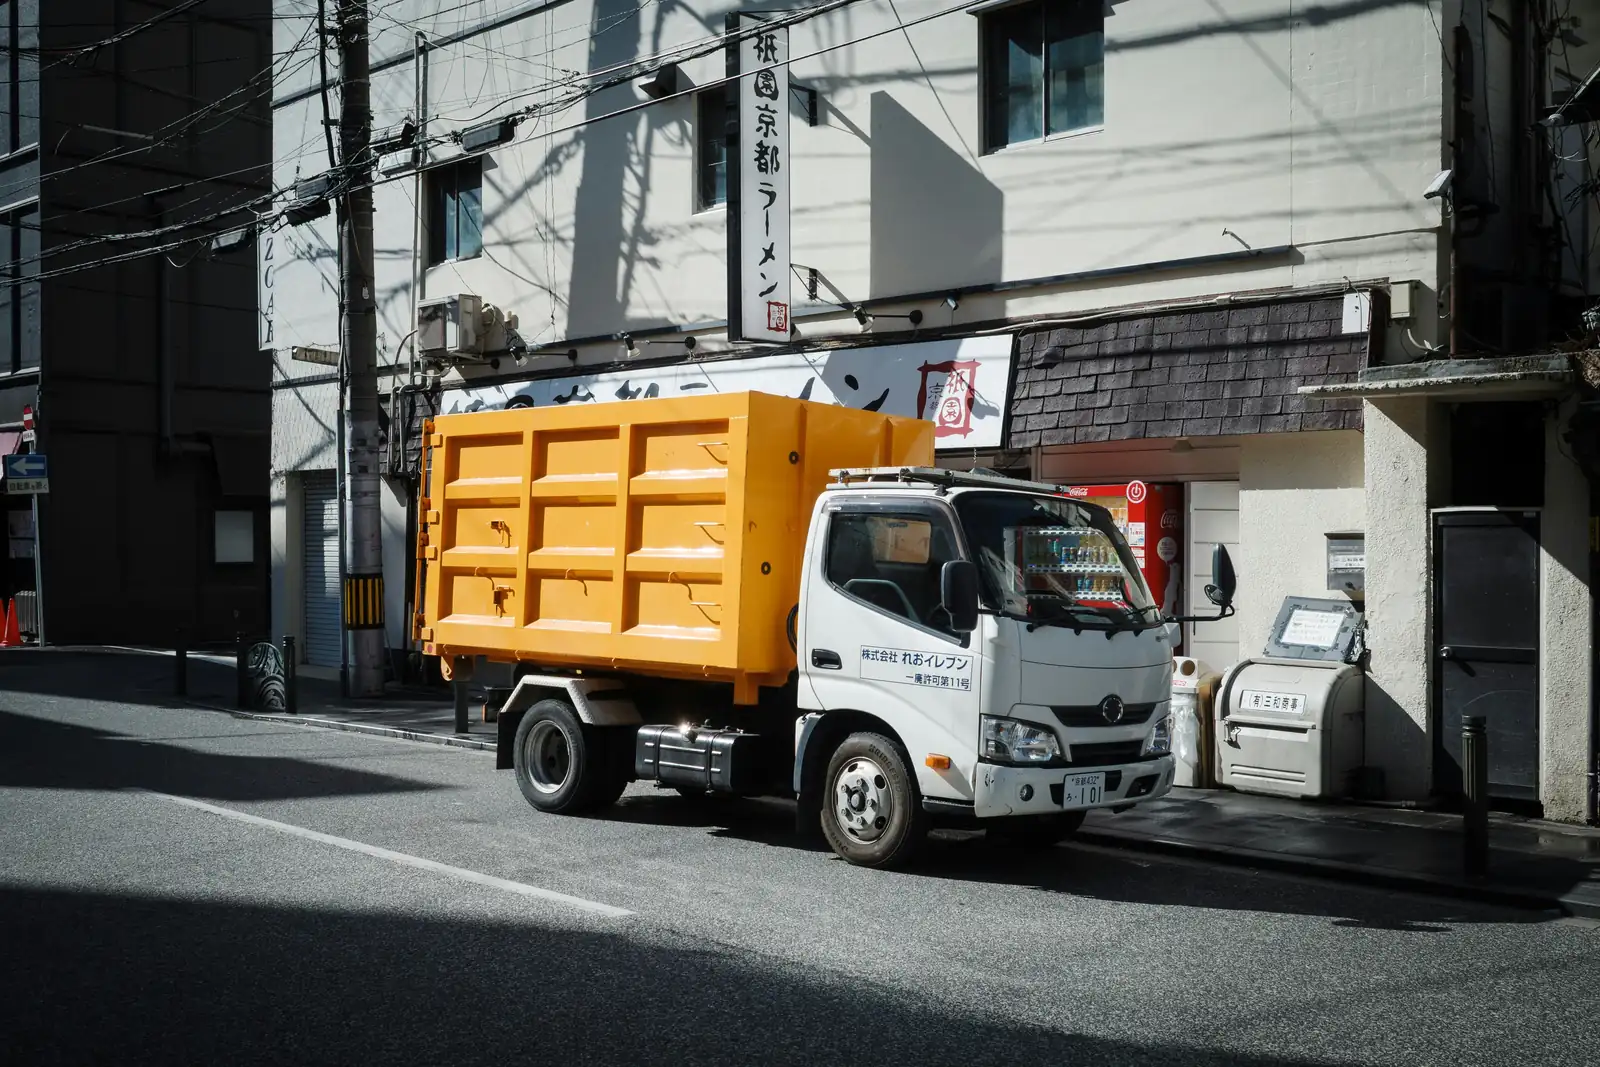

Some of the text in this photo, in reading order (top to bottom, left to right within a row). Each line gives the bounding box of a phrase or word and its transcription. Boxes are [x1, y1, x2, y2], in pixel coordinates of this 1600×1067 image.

[862, 649, 968, 670] 株式会社 れおイレブン
